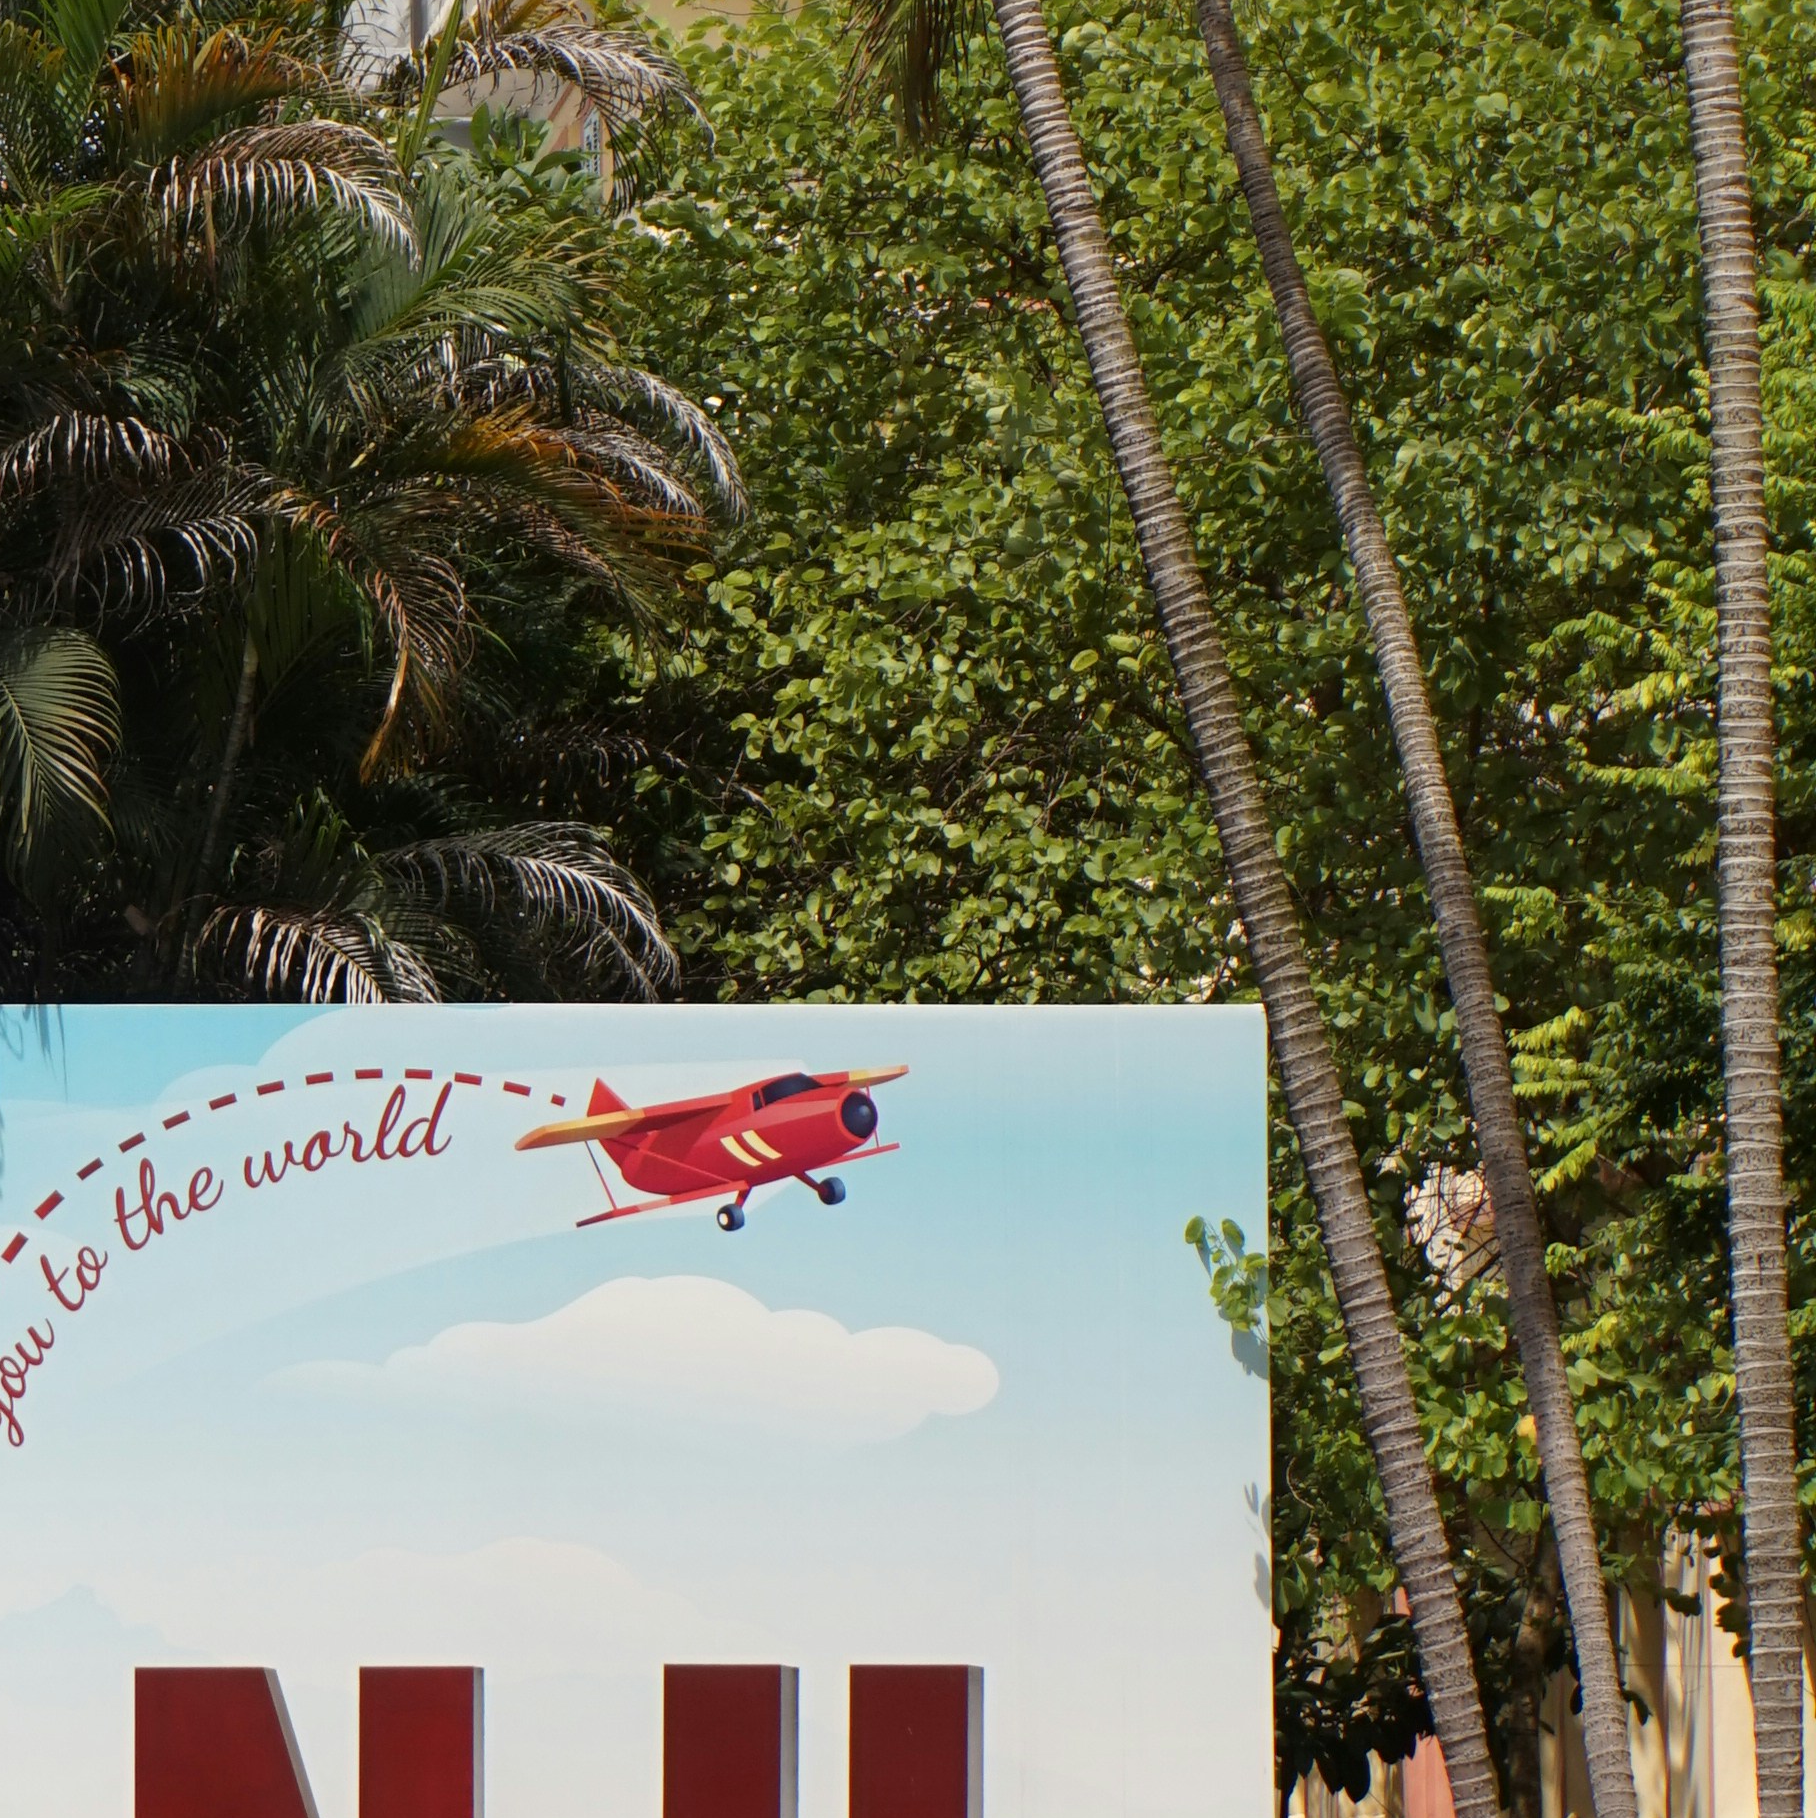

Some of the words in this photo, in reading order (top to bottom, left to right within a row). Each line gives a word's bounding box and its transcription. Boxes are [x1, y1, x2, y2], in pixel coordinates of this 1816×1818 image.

[39, 1245, 109, 1312] to
[114, 1157, 224, 1251] the
[242, 1080, 453, 1190] world
